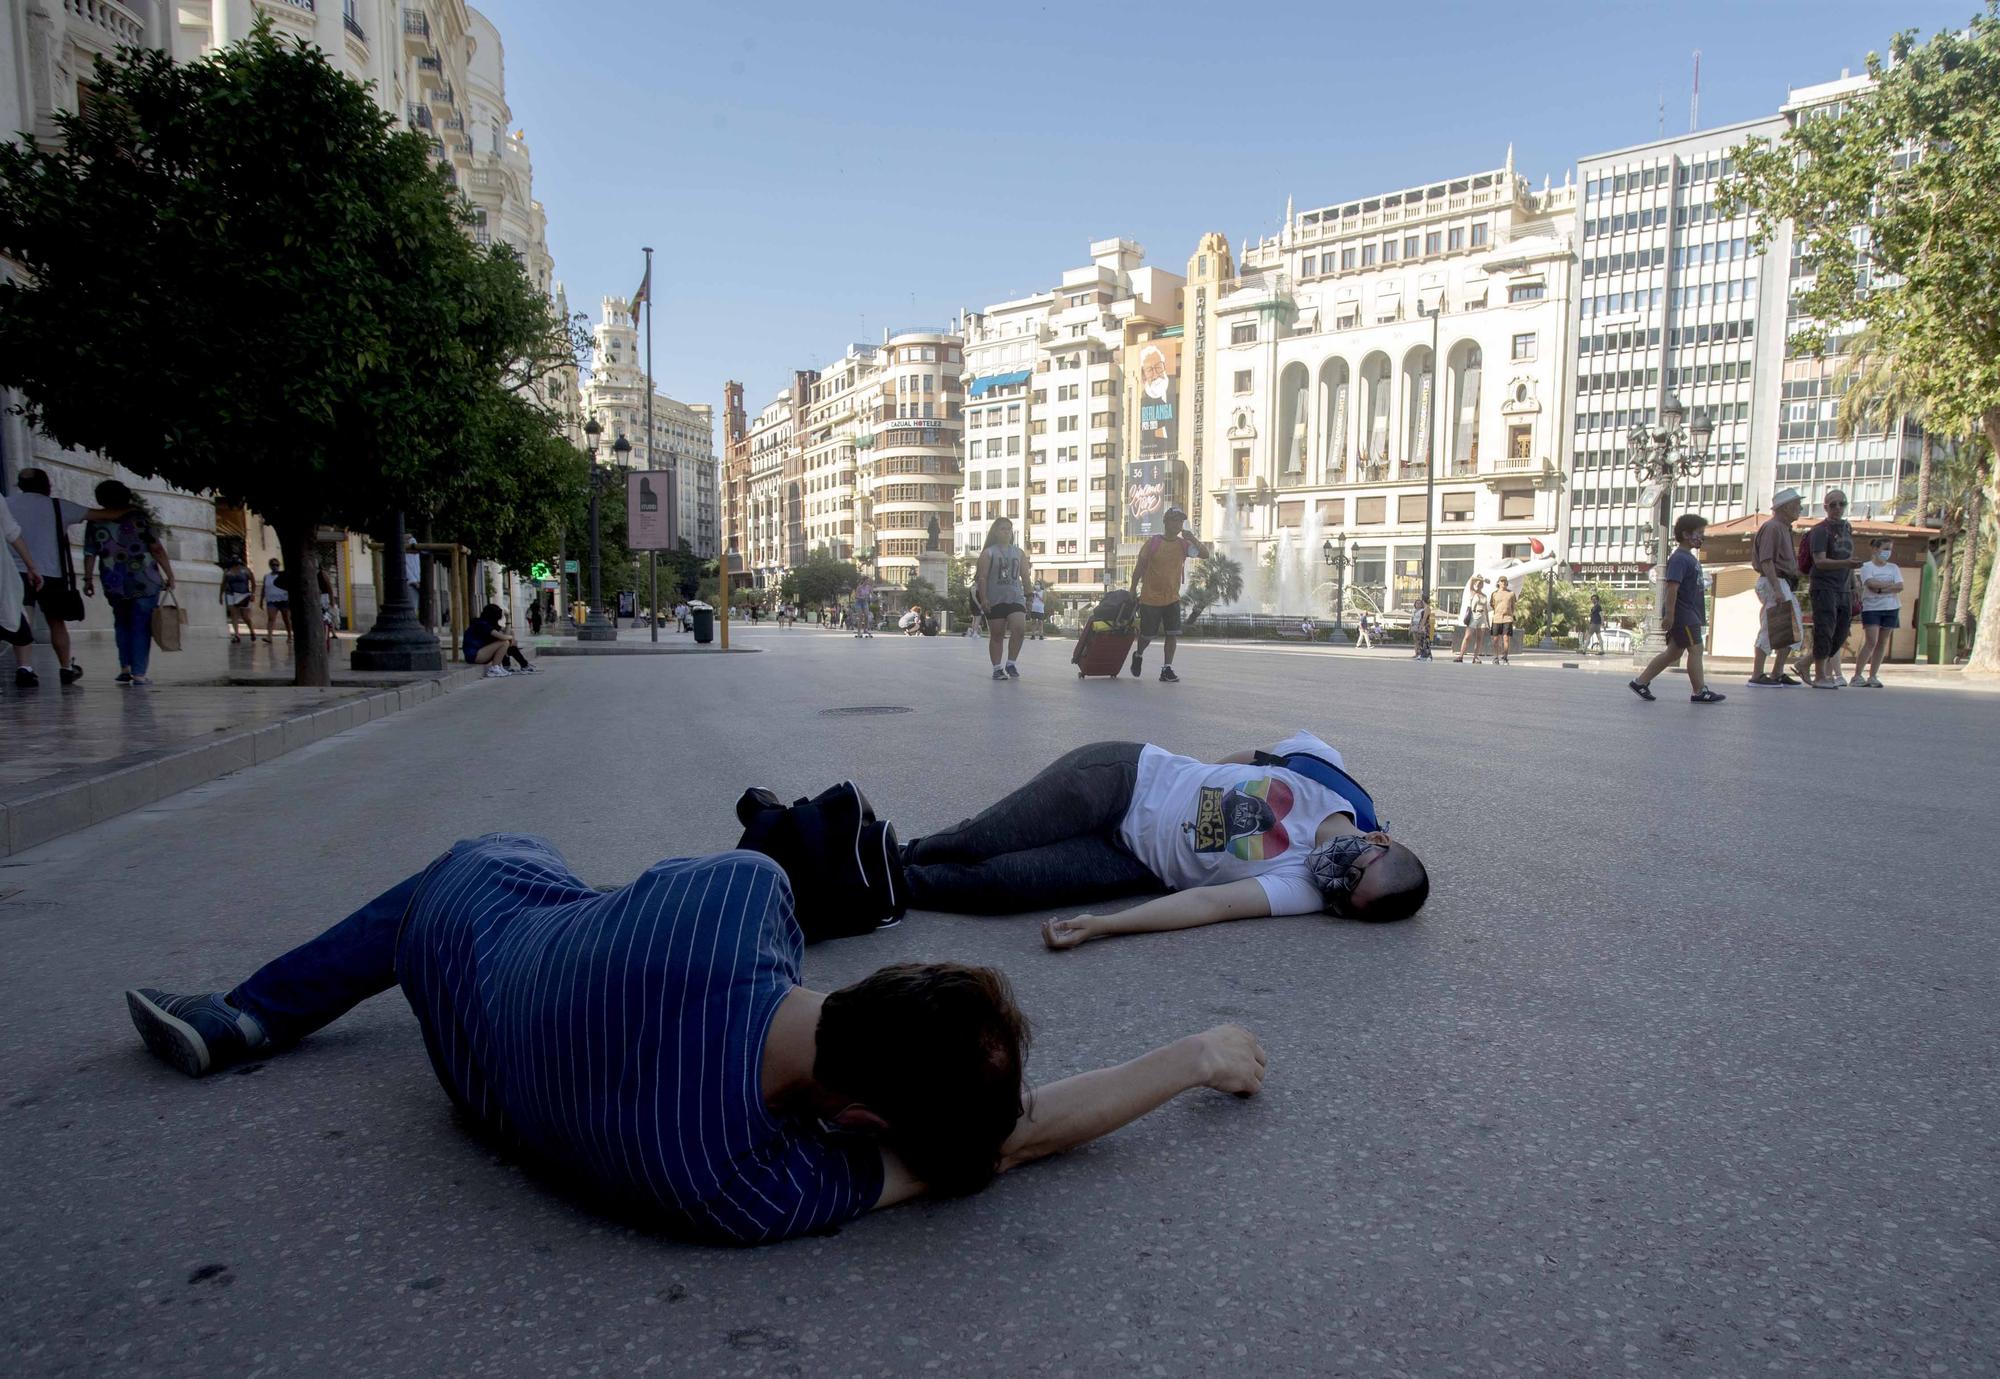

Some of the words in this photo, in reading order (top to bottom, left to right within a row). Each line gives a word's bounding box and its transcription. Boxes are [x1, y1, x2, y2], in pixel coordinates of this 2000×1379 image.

[1195, 296, 1206, 359] RIALTO
[1142, 403, 1172, 421] BERLANGA
[1132, 468, 1143, 478] 36
[1581, 565, 1614, 573] BURGER
[1617, 565, 1639, 573] KING
[1197, 790, 1214, 850] FORÇA
[1214, 828, 1224, 847] LA
